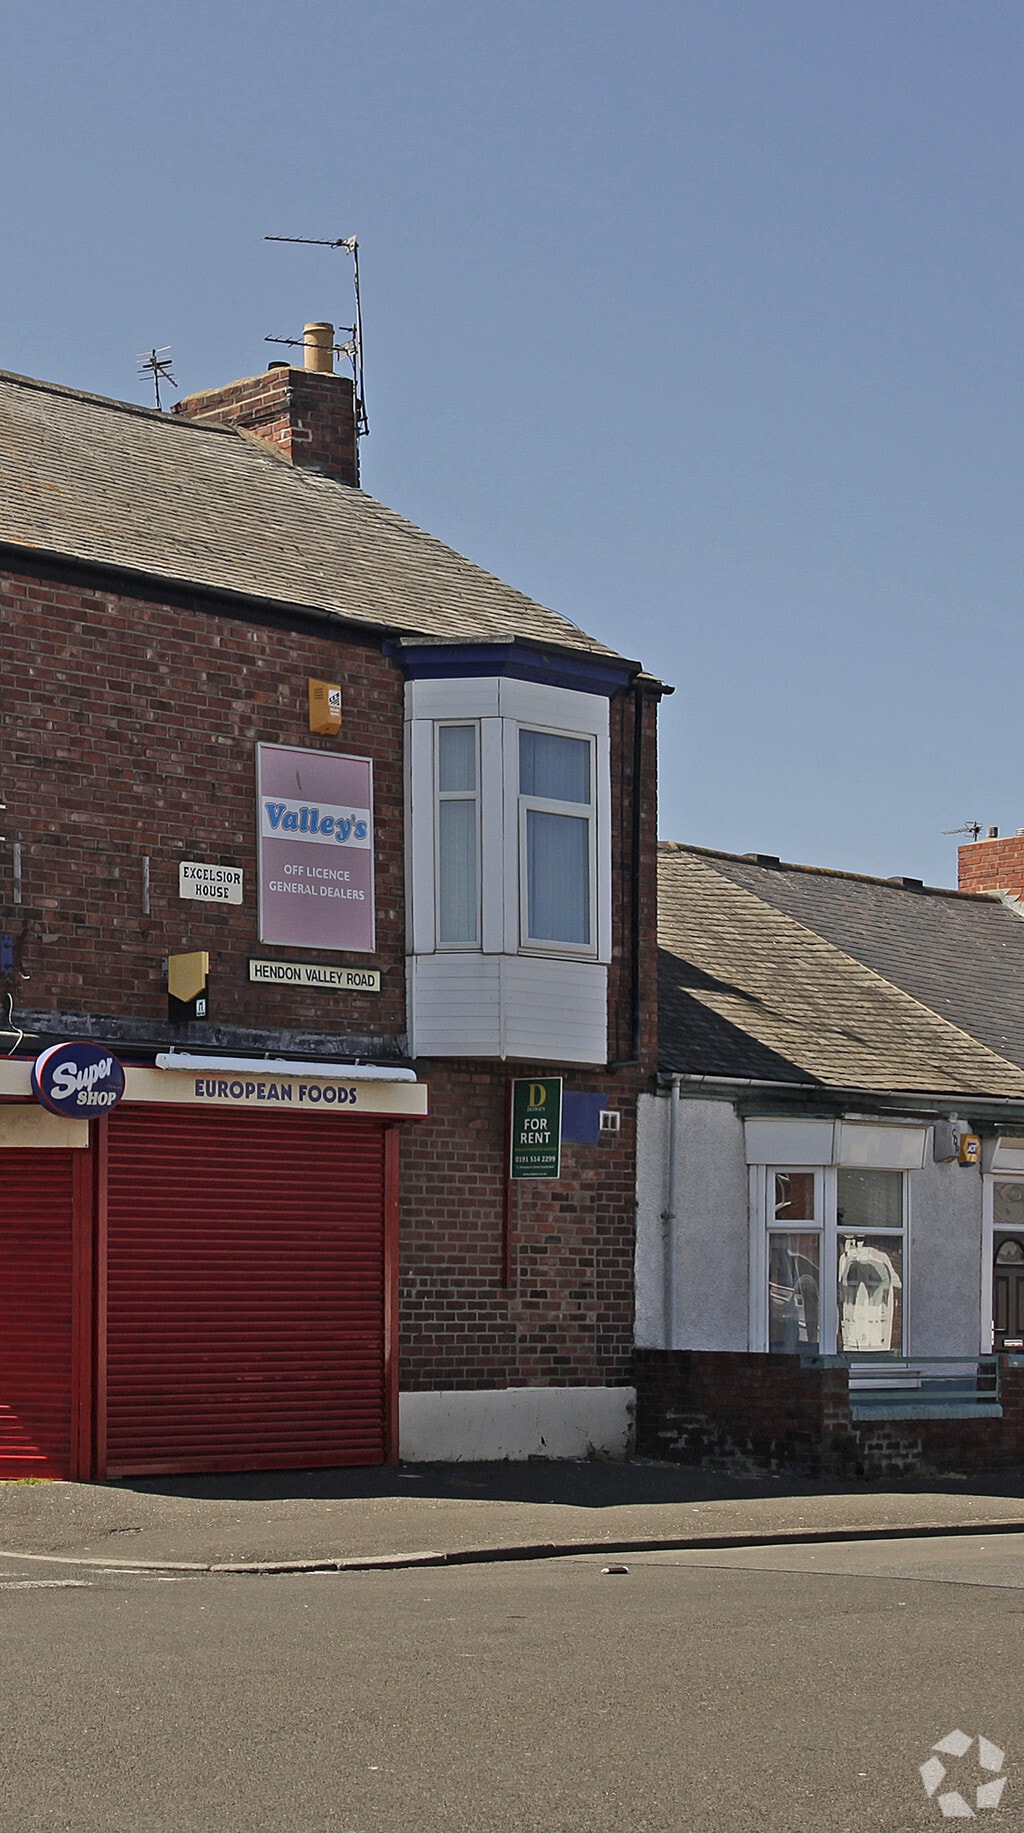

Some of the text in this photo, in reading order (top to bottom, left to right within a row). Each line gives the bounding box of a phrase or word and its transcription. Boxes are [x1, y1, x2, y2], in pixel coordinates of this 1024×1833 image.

[265, 802, 368, 842] Valley's
[183, 866, 241, 885] EXCELSIOR
[283, 864, 350, 881] OFF LICENCE
[195, 884, 229, 899] HOUSE
[269, 880, 365, 900] GENERAL DEALERS
[254, 964, 375, 987] HENDON VALLEY ROAD
[50, 1057, 113, 1100] Super
[76, 1091, 117, 1106] SHOP
[195, 1079, 357, 1104] EUROPEAN FOODS
[528, 1083, 547, 1107] D
[524, 1118, 548, 1130] FOR
[520, 1132, 551, 1144] RENT
